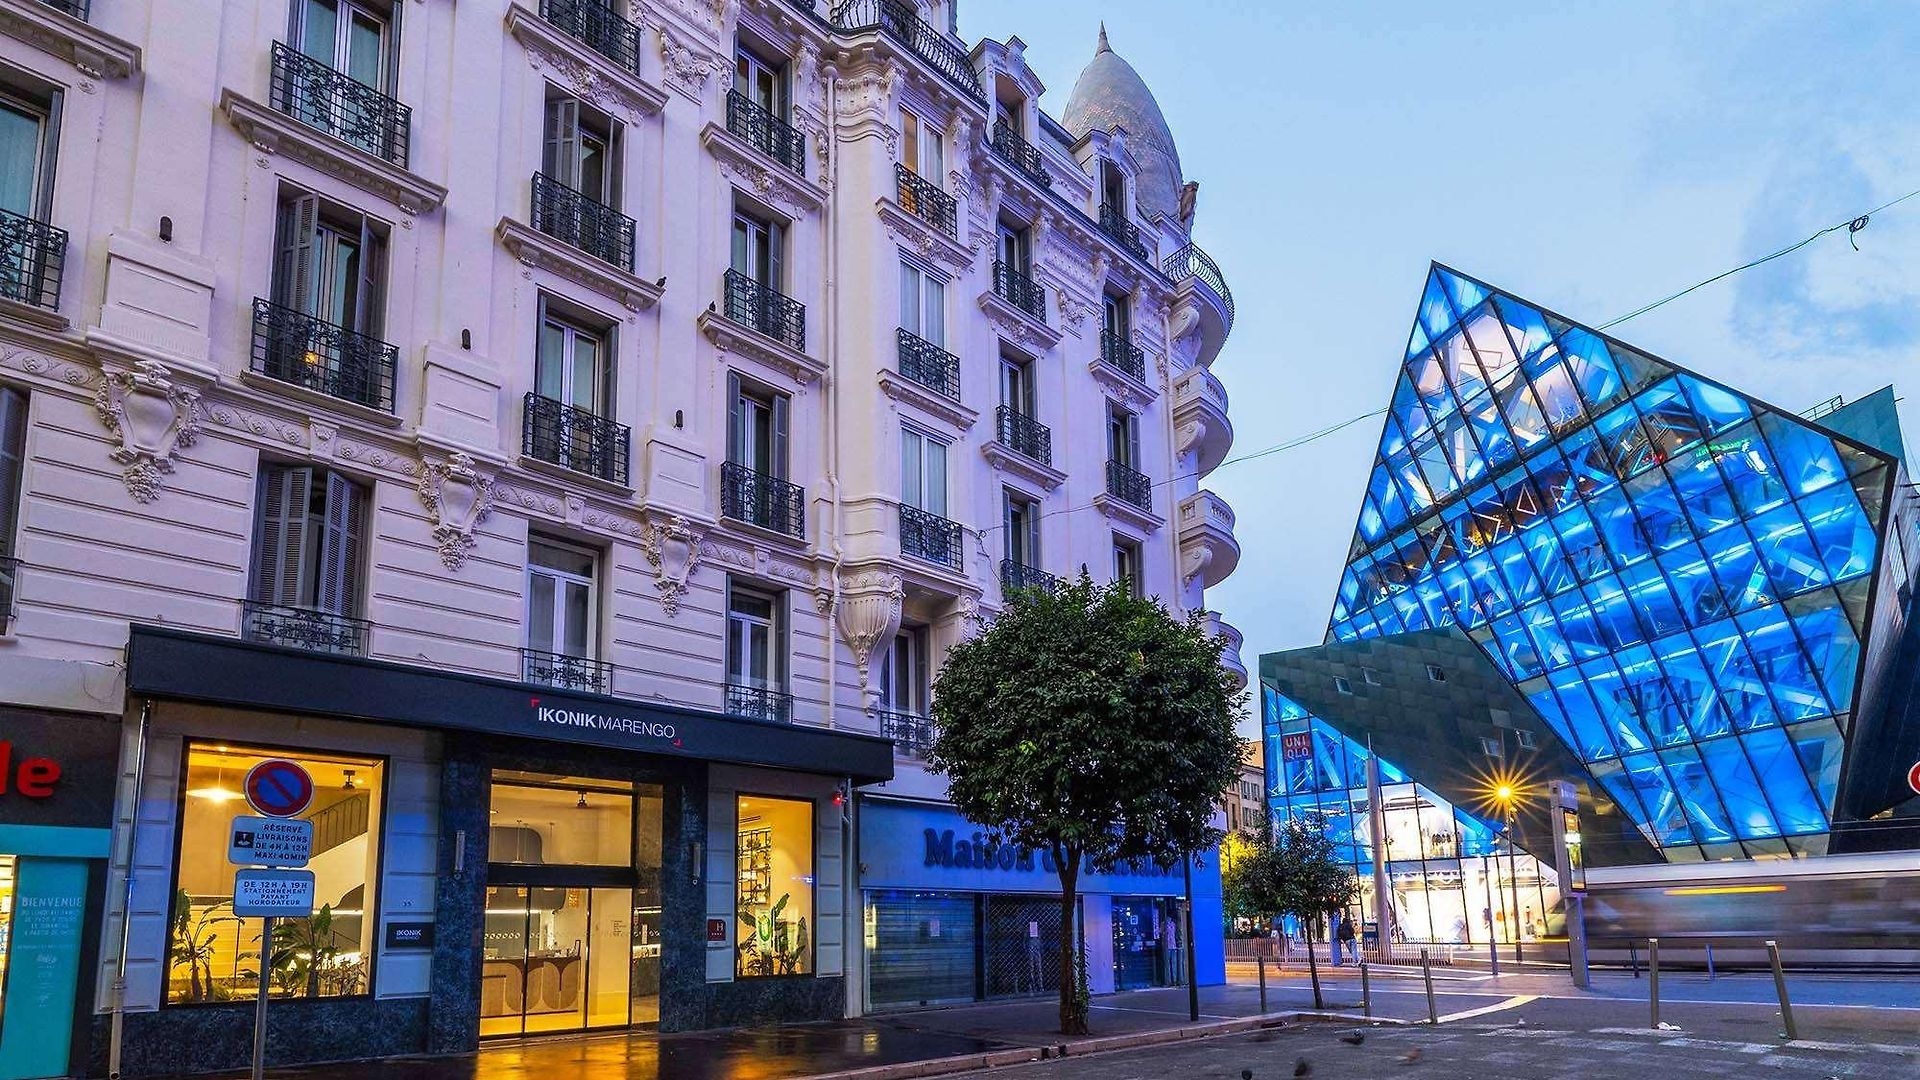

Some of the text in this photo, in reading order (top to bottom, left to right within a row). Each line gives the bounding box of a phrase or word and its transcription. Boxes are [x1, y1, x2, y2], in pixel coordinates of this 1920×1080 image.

[538, 707, 676, 739] IKONIK MARENGO
[1286, 735, 1306, 747] UNI
[1287, 747, 1309, 760] QLO
[256, 833, 308, 843] LIVRAISONS
[21, 897, 82, 907] BIENVENUE
